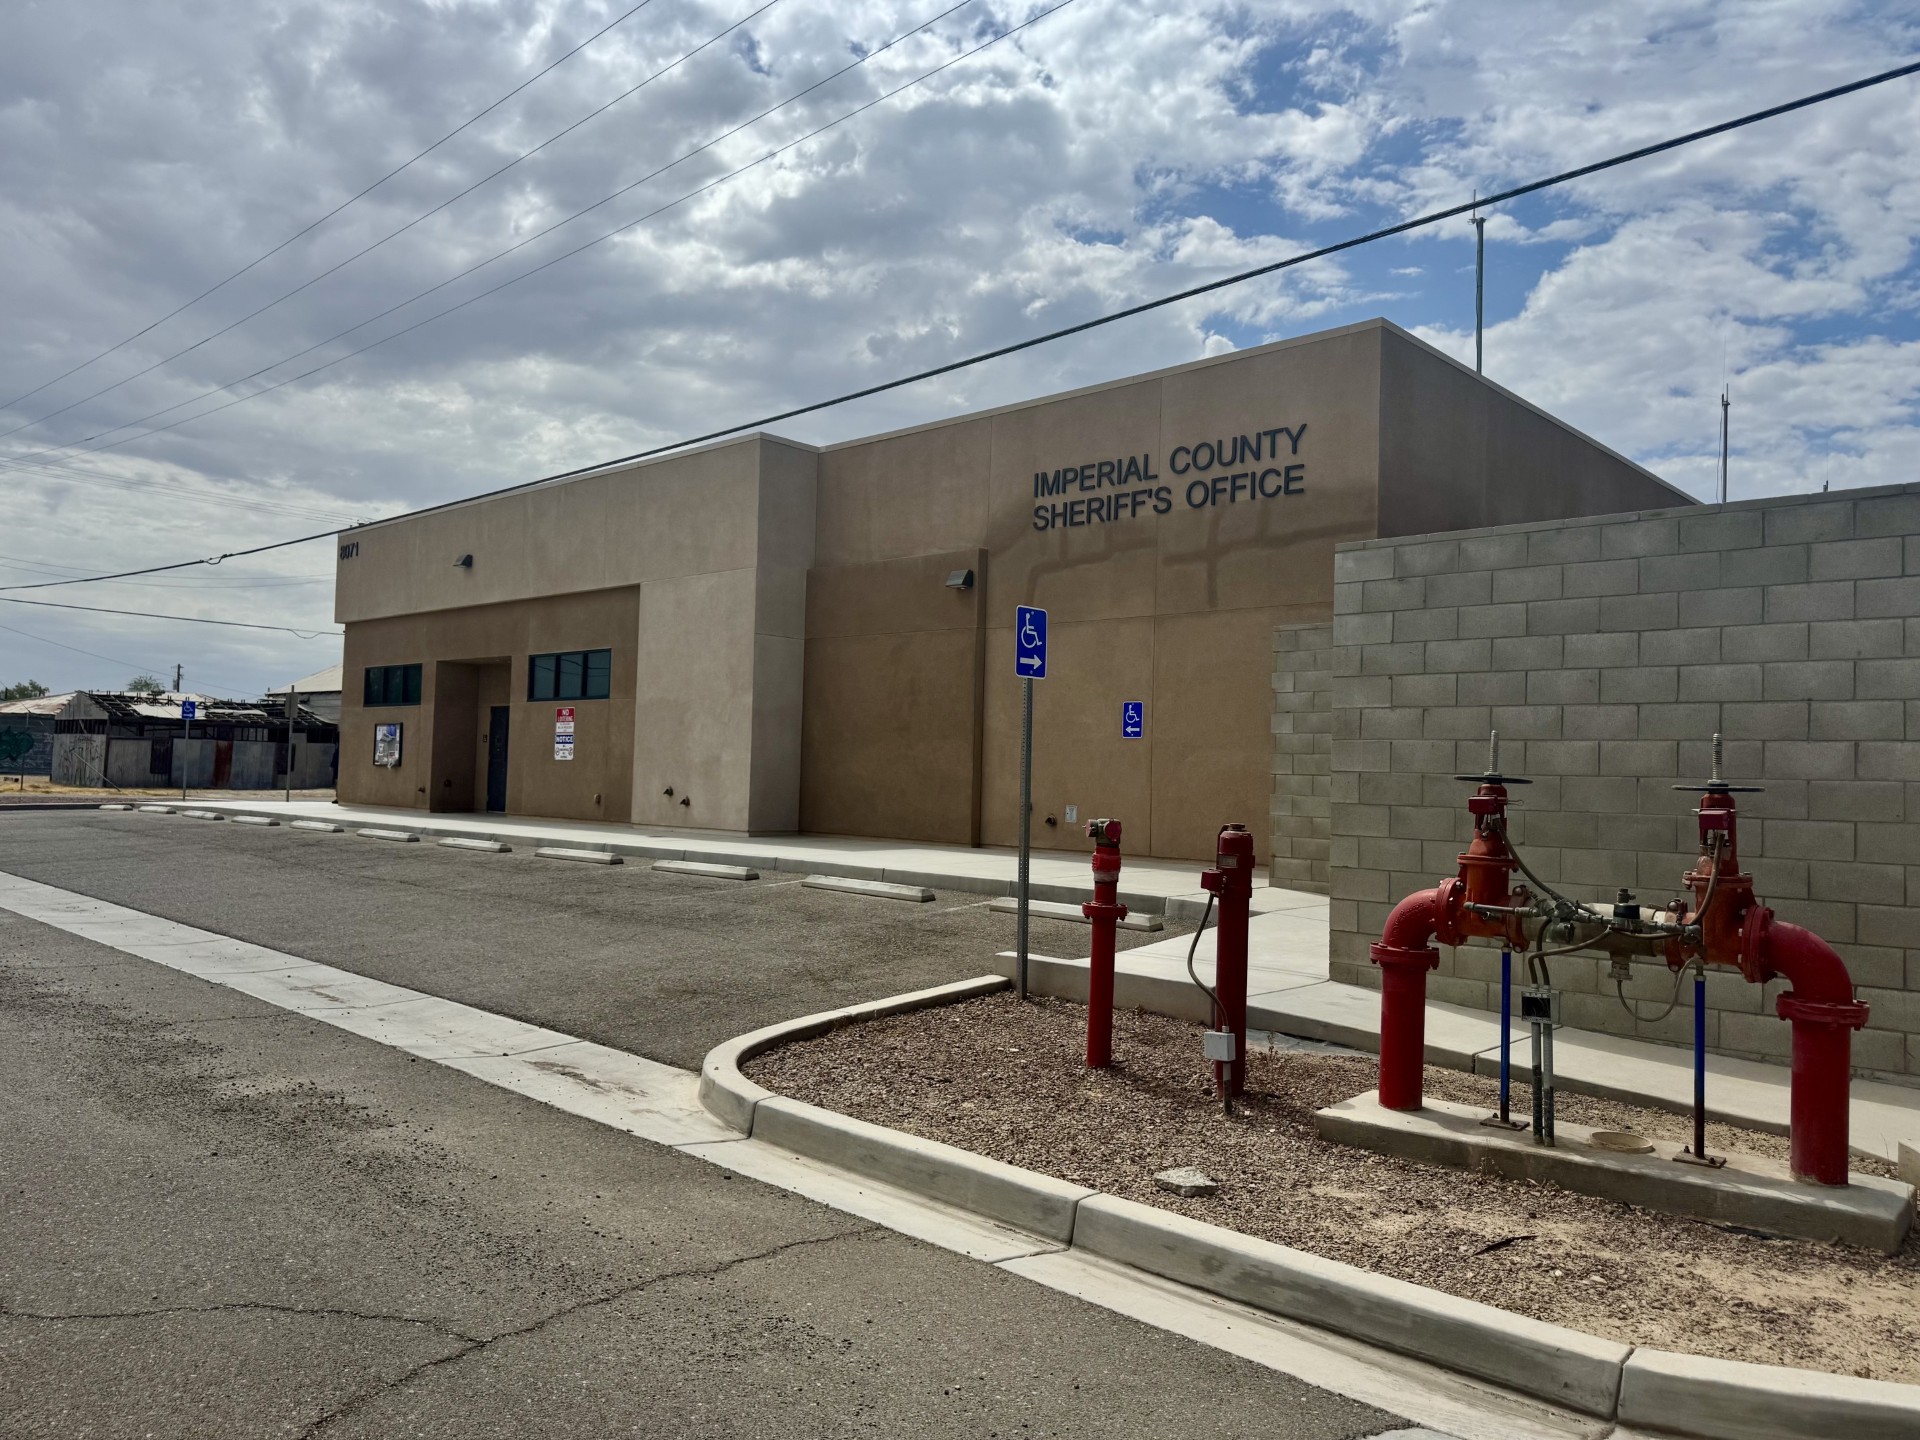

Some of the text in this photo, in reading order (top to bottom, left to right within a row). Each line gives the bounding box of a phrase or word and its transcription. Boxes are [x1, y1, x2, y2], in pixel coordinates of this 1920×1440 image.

[1034, 423, 1307, 498] IMPERIAL COUNTY
[1033, 464, 1305, 531] SHERIFF'S OFFICE
[556, 735, 573, 743] NOTICE
